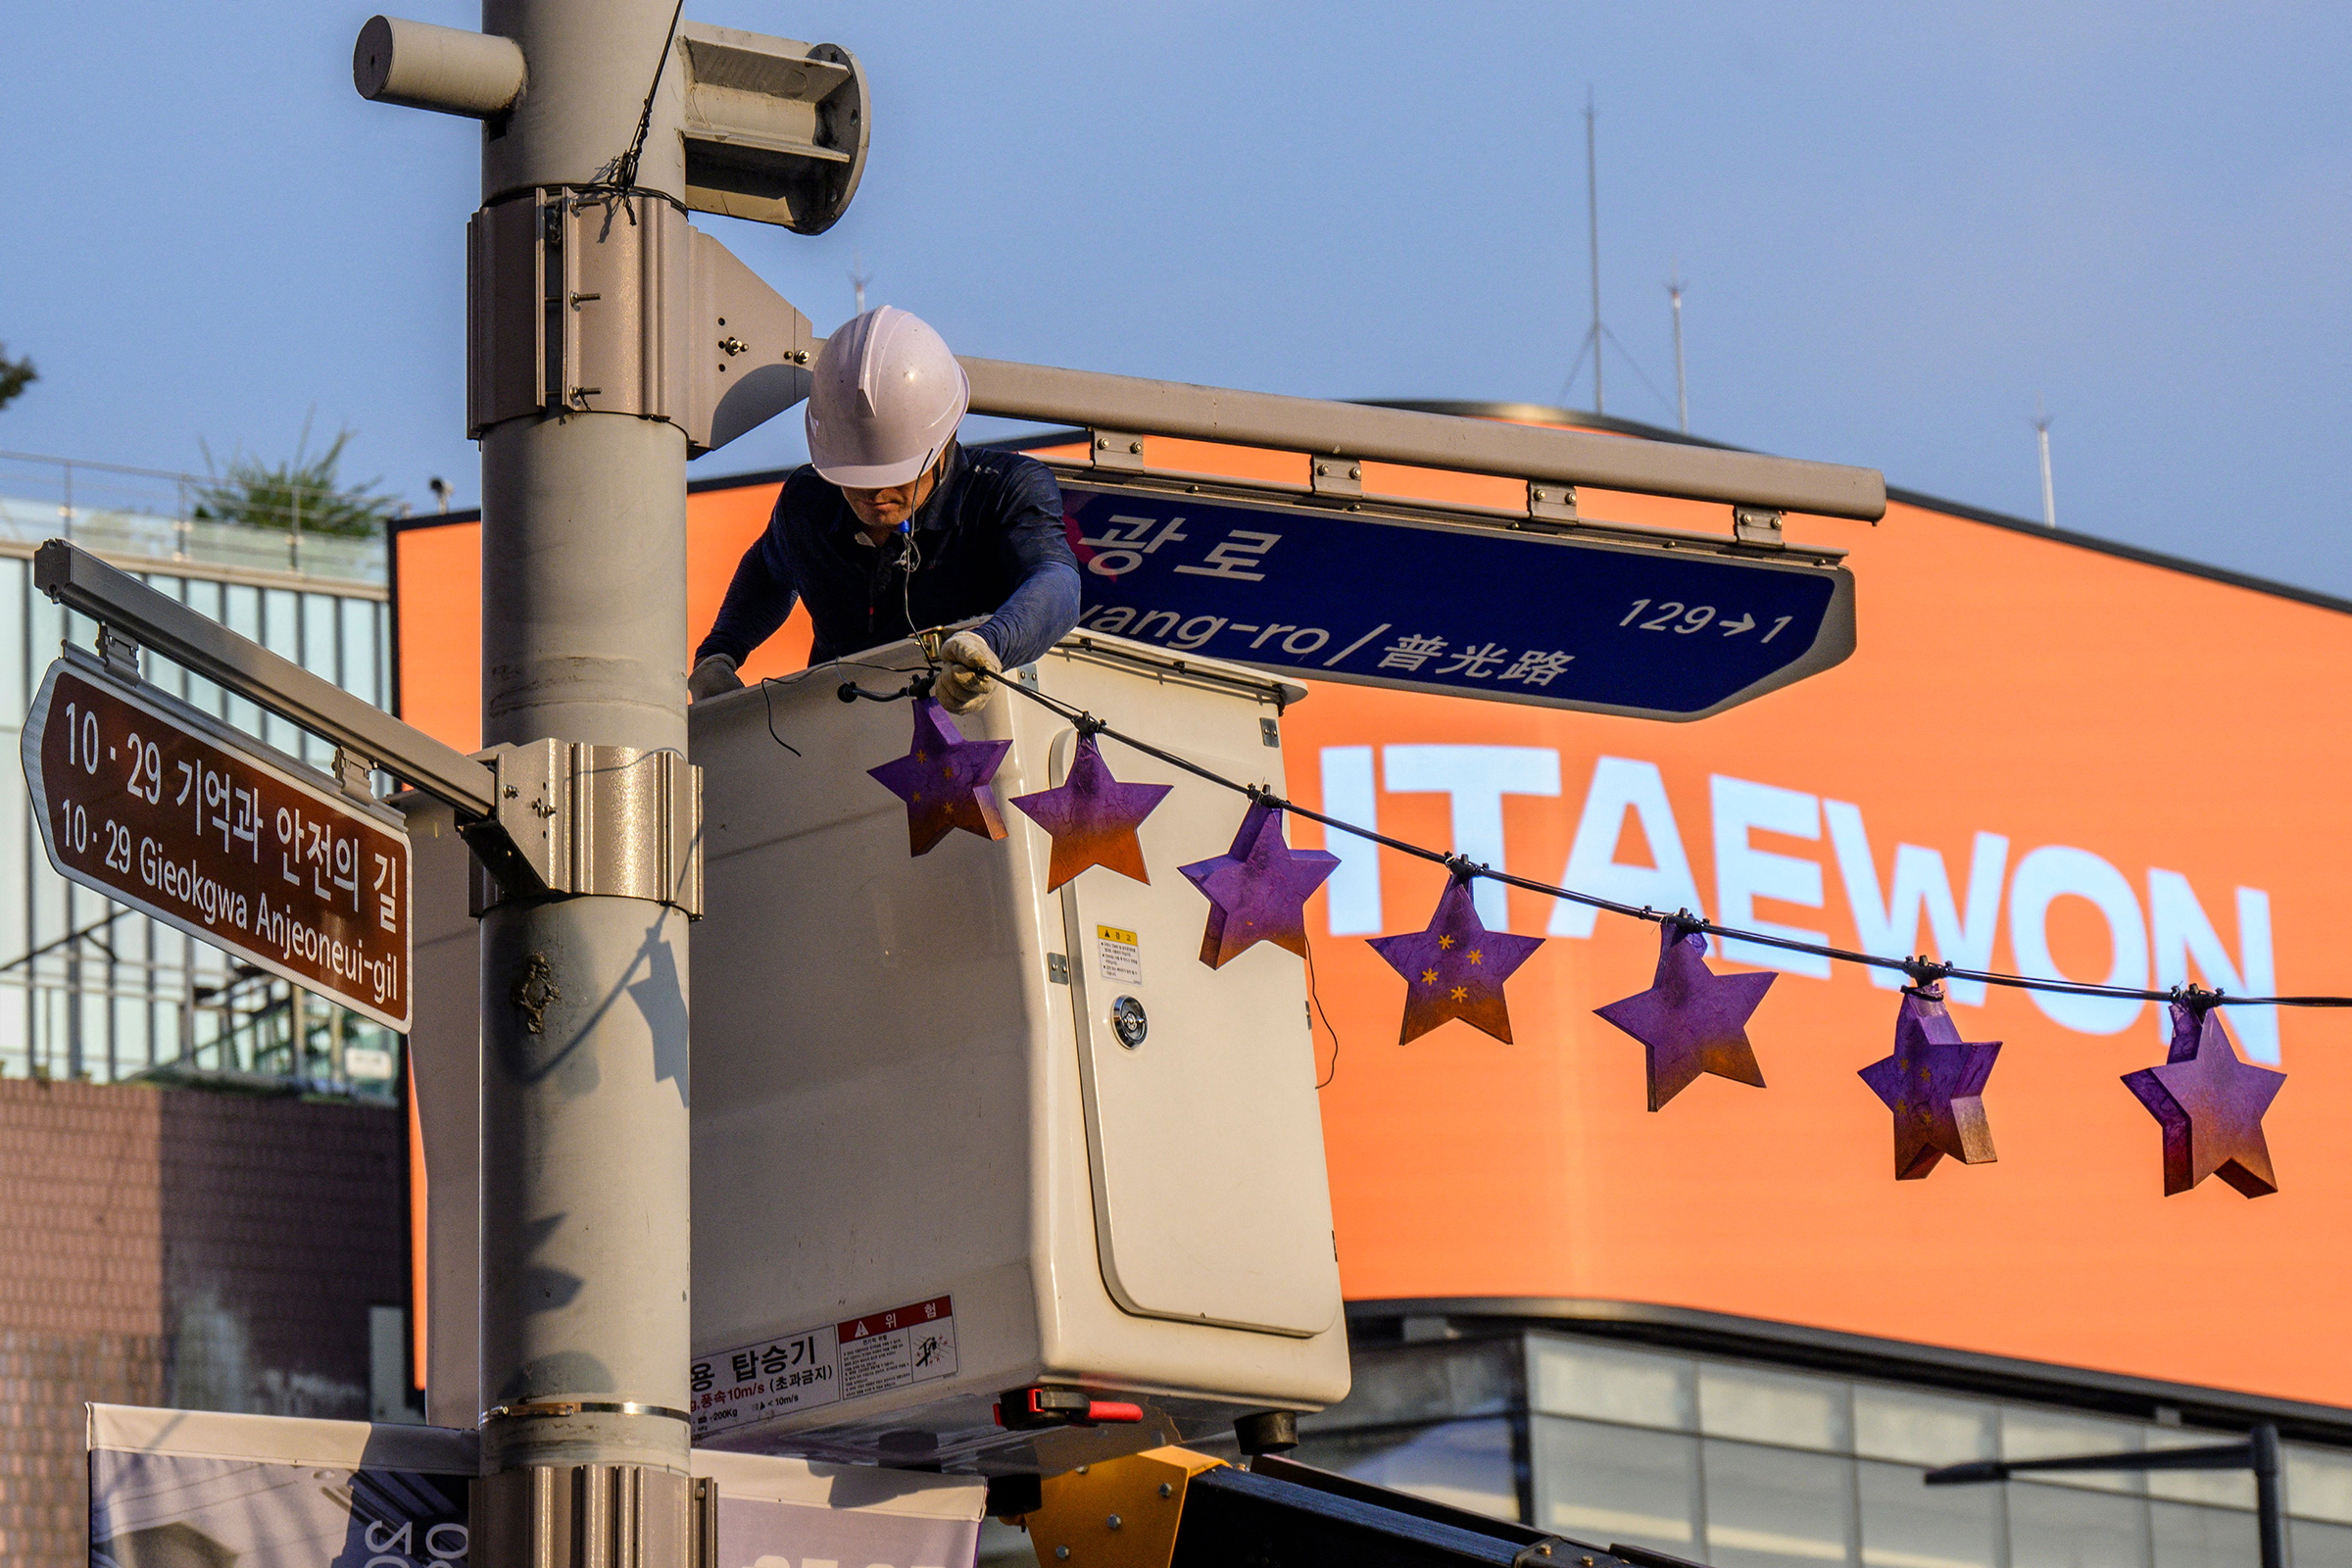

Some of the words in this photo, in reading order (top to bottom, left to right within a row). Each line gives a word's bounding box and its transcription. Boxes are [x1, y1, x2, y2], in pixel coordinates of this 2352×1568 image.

[1077, 514, 1283, 581] 광로
[1079, 604, 1331, 656] ang-ro
[1377, 633, 1576, 686] 普光路
[1619, 599, 1717, 635] 129
[1761, 615, 1793, 644] 1
[176, 759, 264, 864] 기억과
[276, 807, 359, 912] 안전의
[373, 853, 397, 934] 길
[140, 836, 248, 930] Gieokgwa
[256, 892, 398, 1004] Anjeoneui-gil
[1318, 744, 2281, 1066] ITAEWON
[731, 1336, 816, 1383] 탑승기
[769, 1364, 833, 1394] (초과금지)
